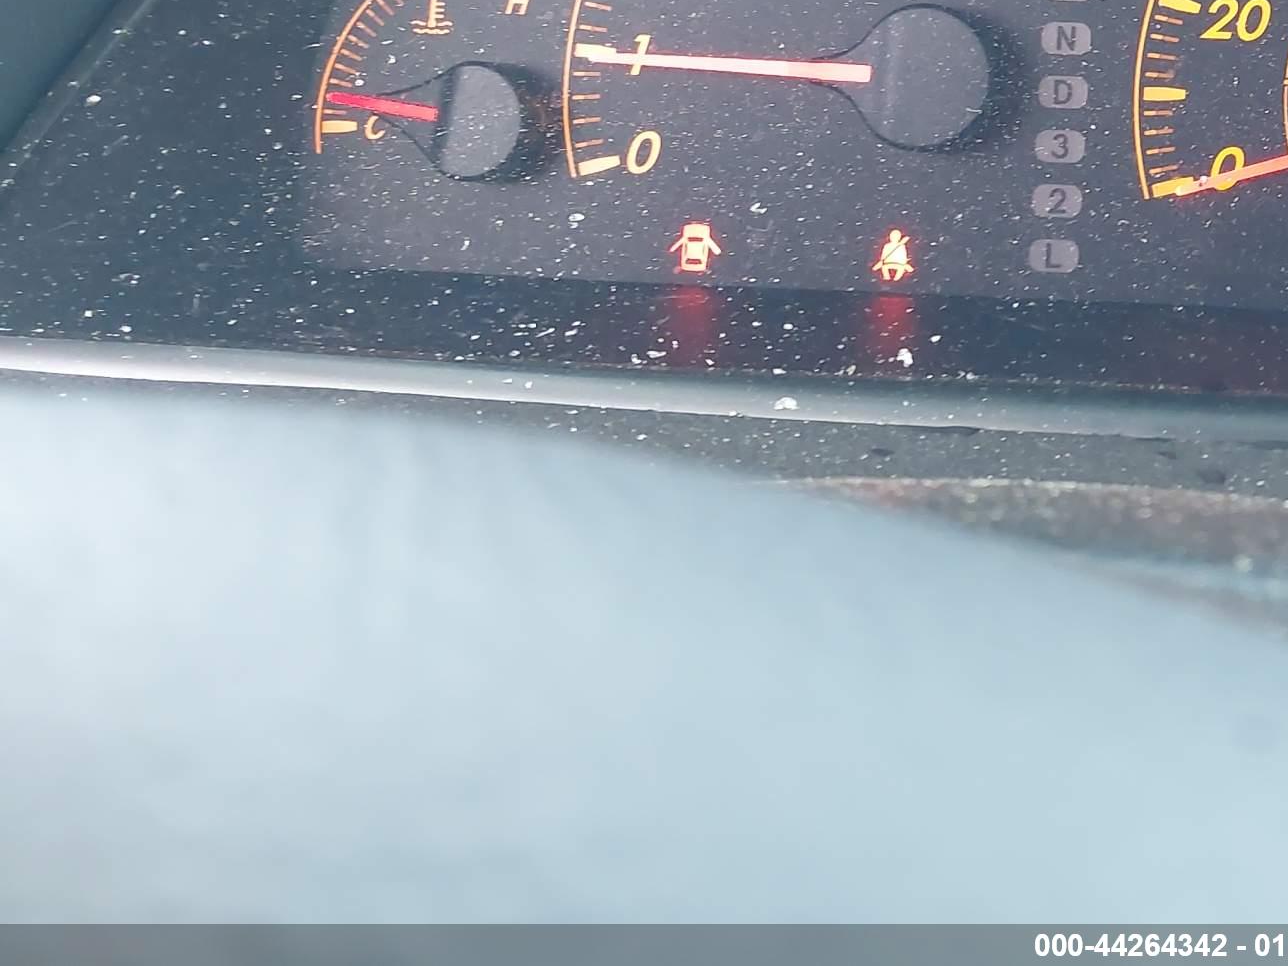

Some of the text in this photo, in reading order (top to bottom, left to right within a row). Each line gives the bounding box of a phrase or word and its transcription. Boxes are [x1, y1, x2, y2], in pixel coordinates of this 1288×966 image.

[1056, 25, 1077, 51] N
[629, 33, 652, 76] 1
[1053, 79, 1073, 105] D
[627, 130, 663, 175] 0
[1050, 133, 1070, 160] 3
[1210, 146, 1245, 191] 0
[1049, 188, 1067, 215] 2
[1045, 242, 1061, 269] L
